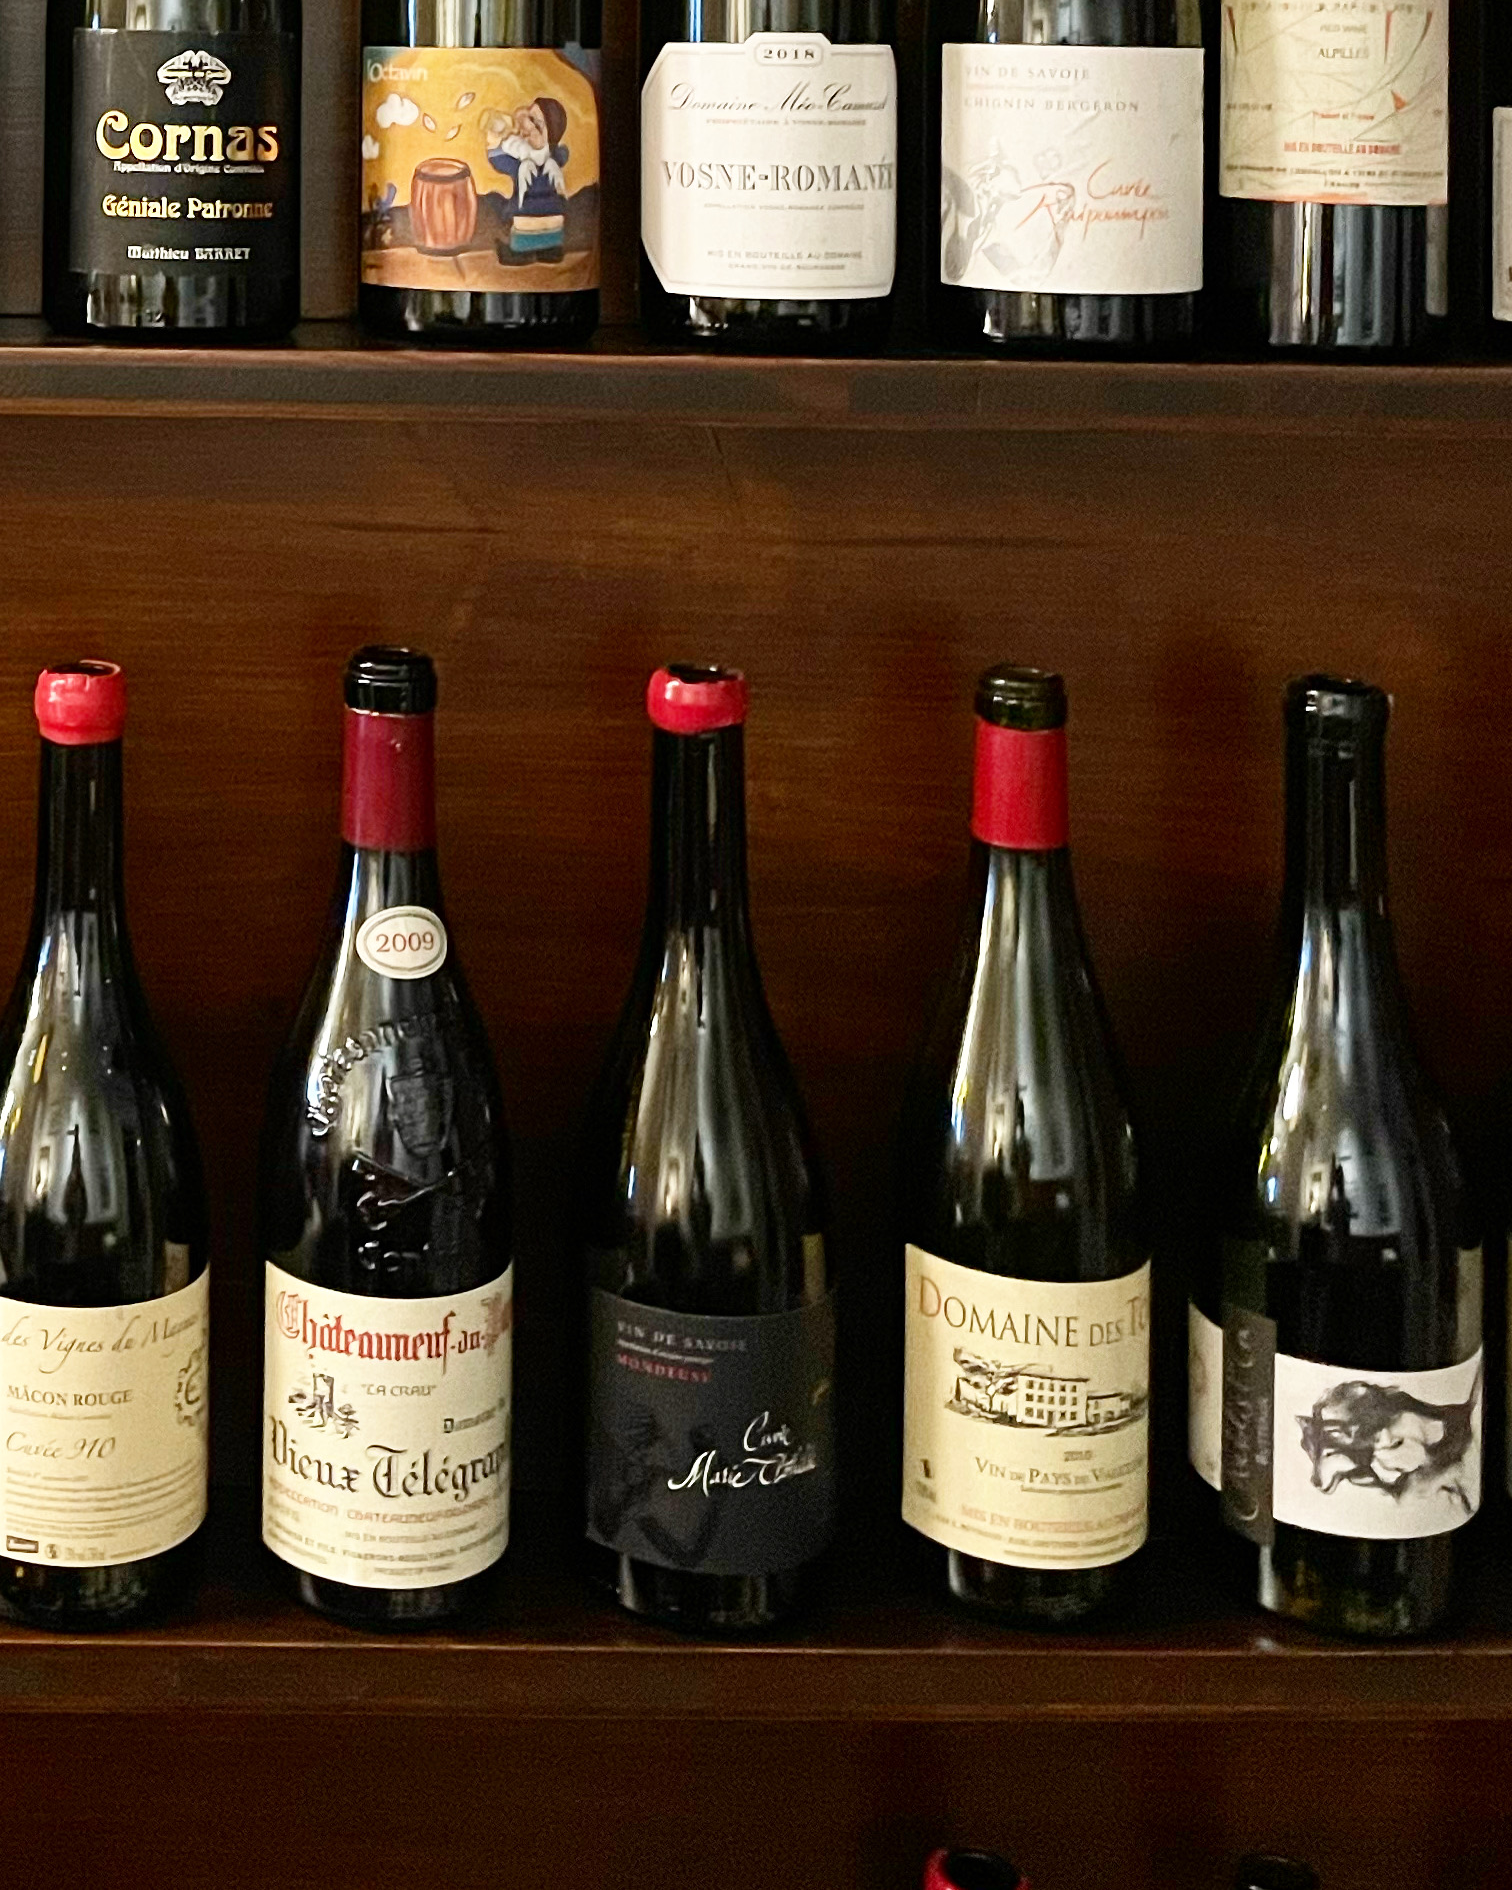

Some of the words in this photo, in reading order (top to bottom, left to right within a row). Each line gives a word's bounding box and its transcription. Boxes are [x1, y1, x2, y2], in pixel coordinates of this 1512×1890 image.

[763, 48, 815, 59] 2018
[1028, 67, 1090, 80] SAVOIE
[668, 82, 760, 111] Domaine
[1044, 100, 1139, 113] BERGERON
[95, 109, 279, 161] Cornas
[102, 193, 181, 219] Géniale
[187, 197, 274, 220] Patronne
[375, 931, 436, 953] 2009
[919, 1274, 1082, 1348] DOMAINE
[1088, 1319, 1125, 1348] DES
[0, 1314, 32, 1348] des
[38, 1327, 104, 1375] Vignes
[7, 1385, 68, 1407] MÂCON
[73, 1388, 135, 1407] ROUGE
[5, 1430, 64, 1461] Cuvée
[268, 1414, 361, 1494] Vieux
[975, 1456, 1007, 1480] VIN
[1028, 1468, 1072, 1486] PAYS
